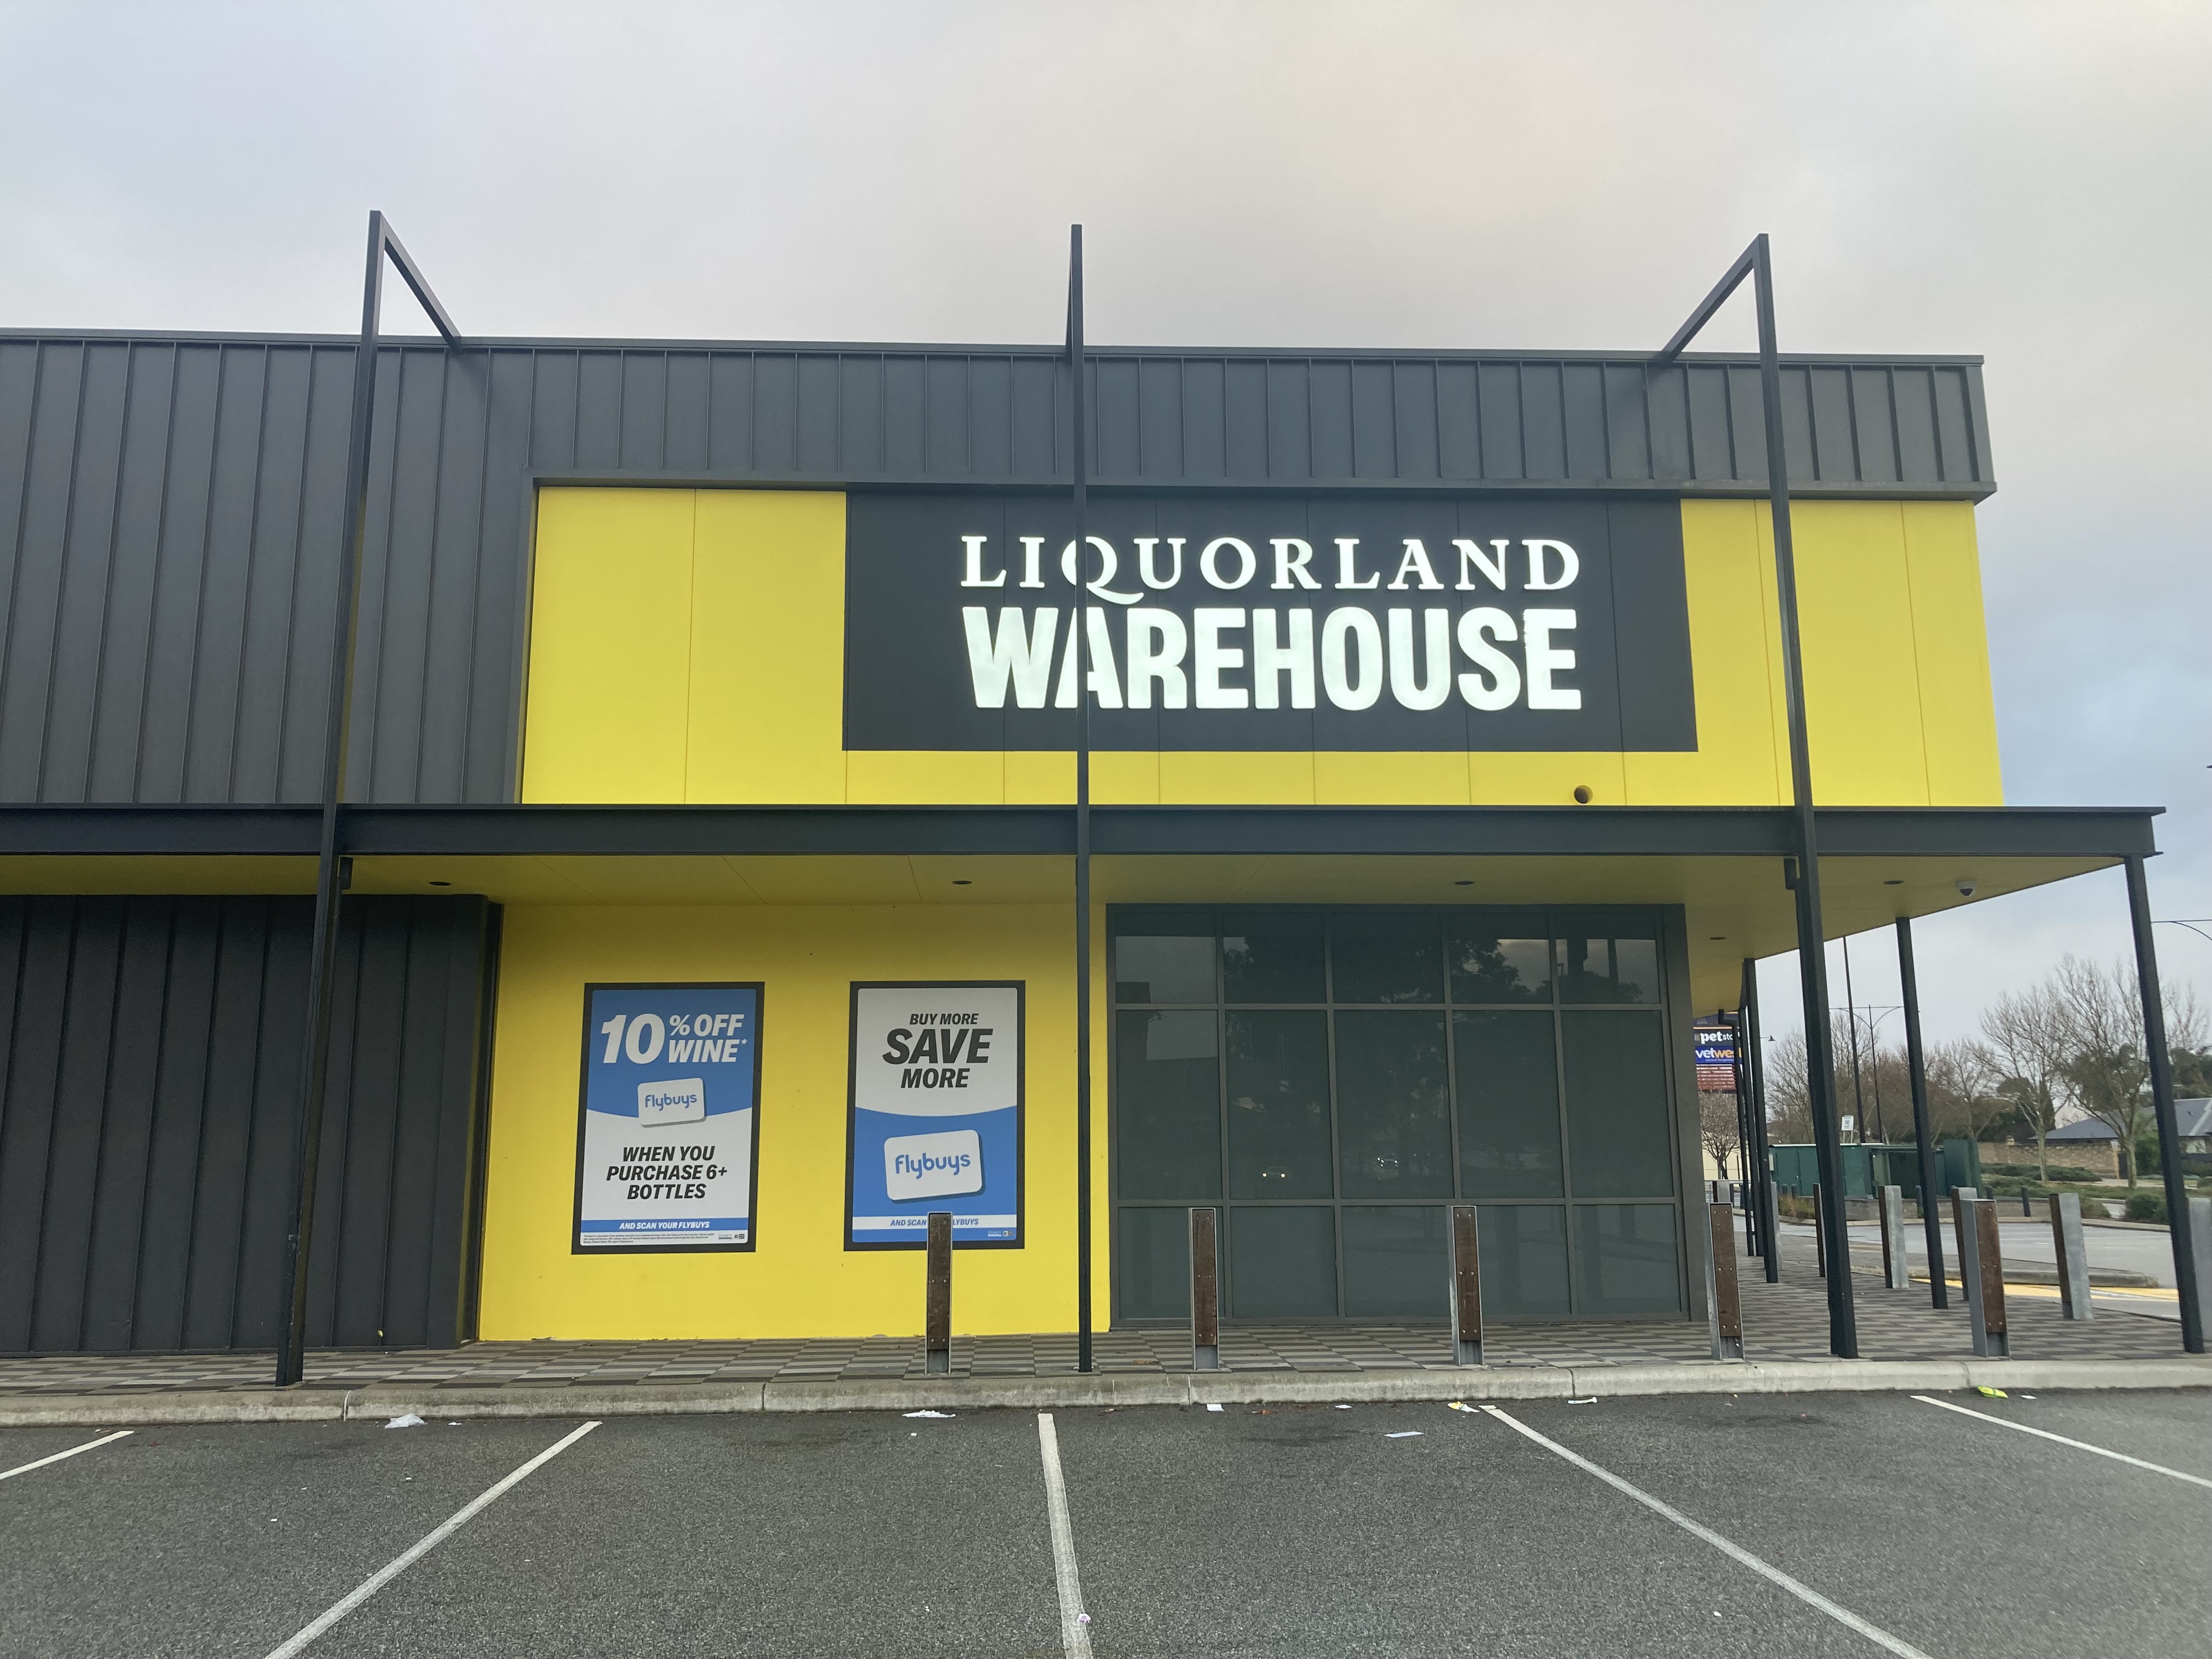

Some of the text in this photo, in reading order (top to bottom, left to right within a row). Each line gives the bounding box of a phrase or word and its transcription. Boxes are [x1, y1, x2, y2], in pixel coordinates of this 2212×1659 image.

[961, 535, 1579, 605] LIQUORLAND
[962, 607, 1581, 711] WAREHOUSE
[910, 1013, 979, 1025] BUY MORE
[882, 1028, 994, 1065] SAVE
[1700, 1031, 1740, 1045] petsto
[1695, 1047, 1741, 1058] vetwe
[901, 1068, 970, 1088] MORE
[645, 1093, 697, 1111] flybuys
[623, 1146, 715, 1162] WHEN YOU
[606, 1164, 727, 1181] PURCHASE 6+
[895, 1153, 970, 1180] flybuys
[627, 1183, 707, 1200] BOTTLES
